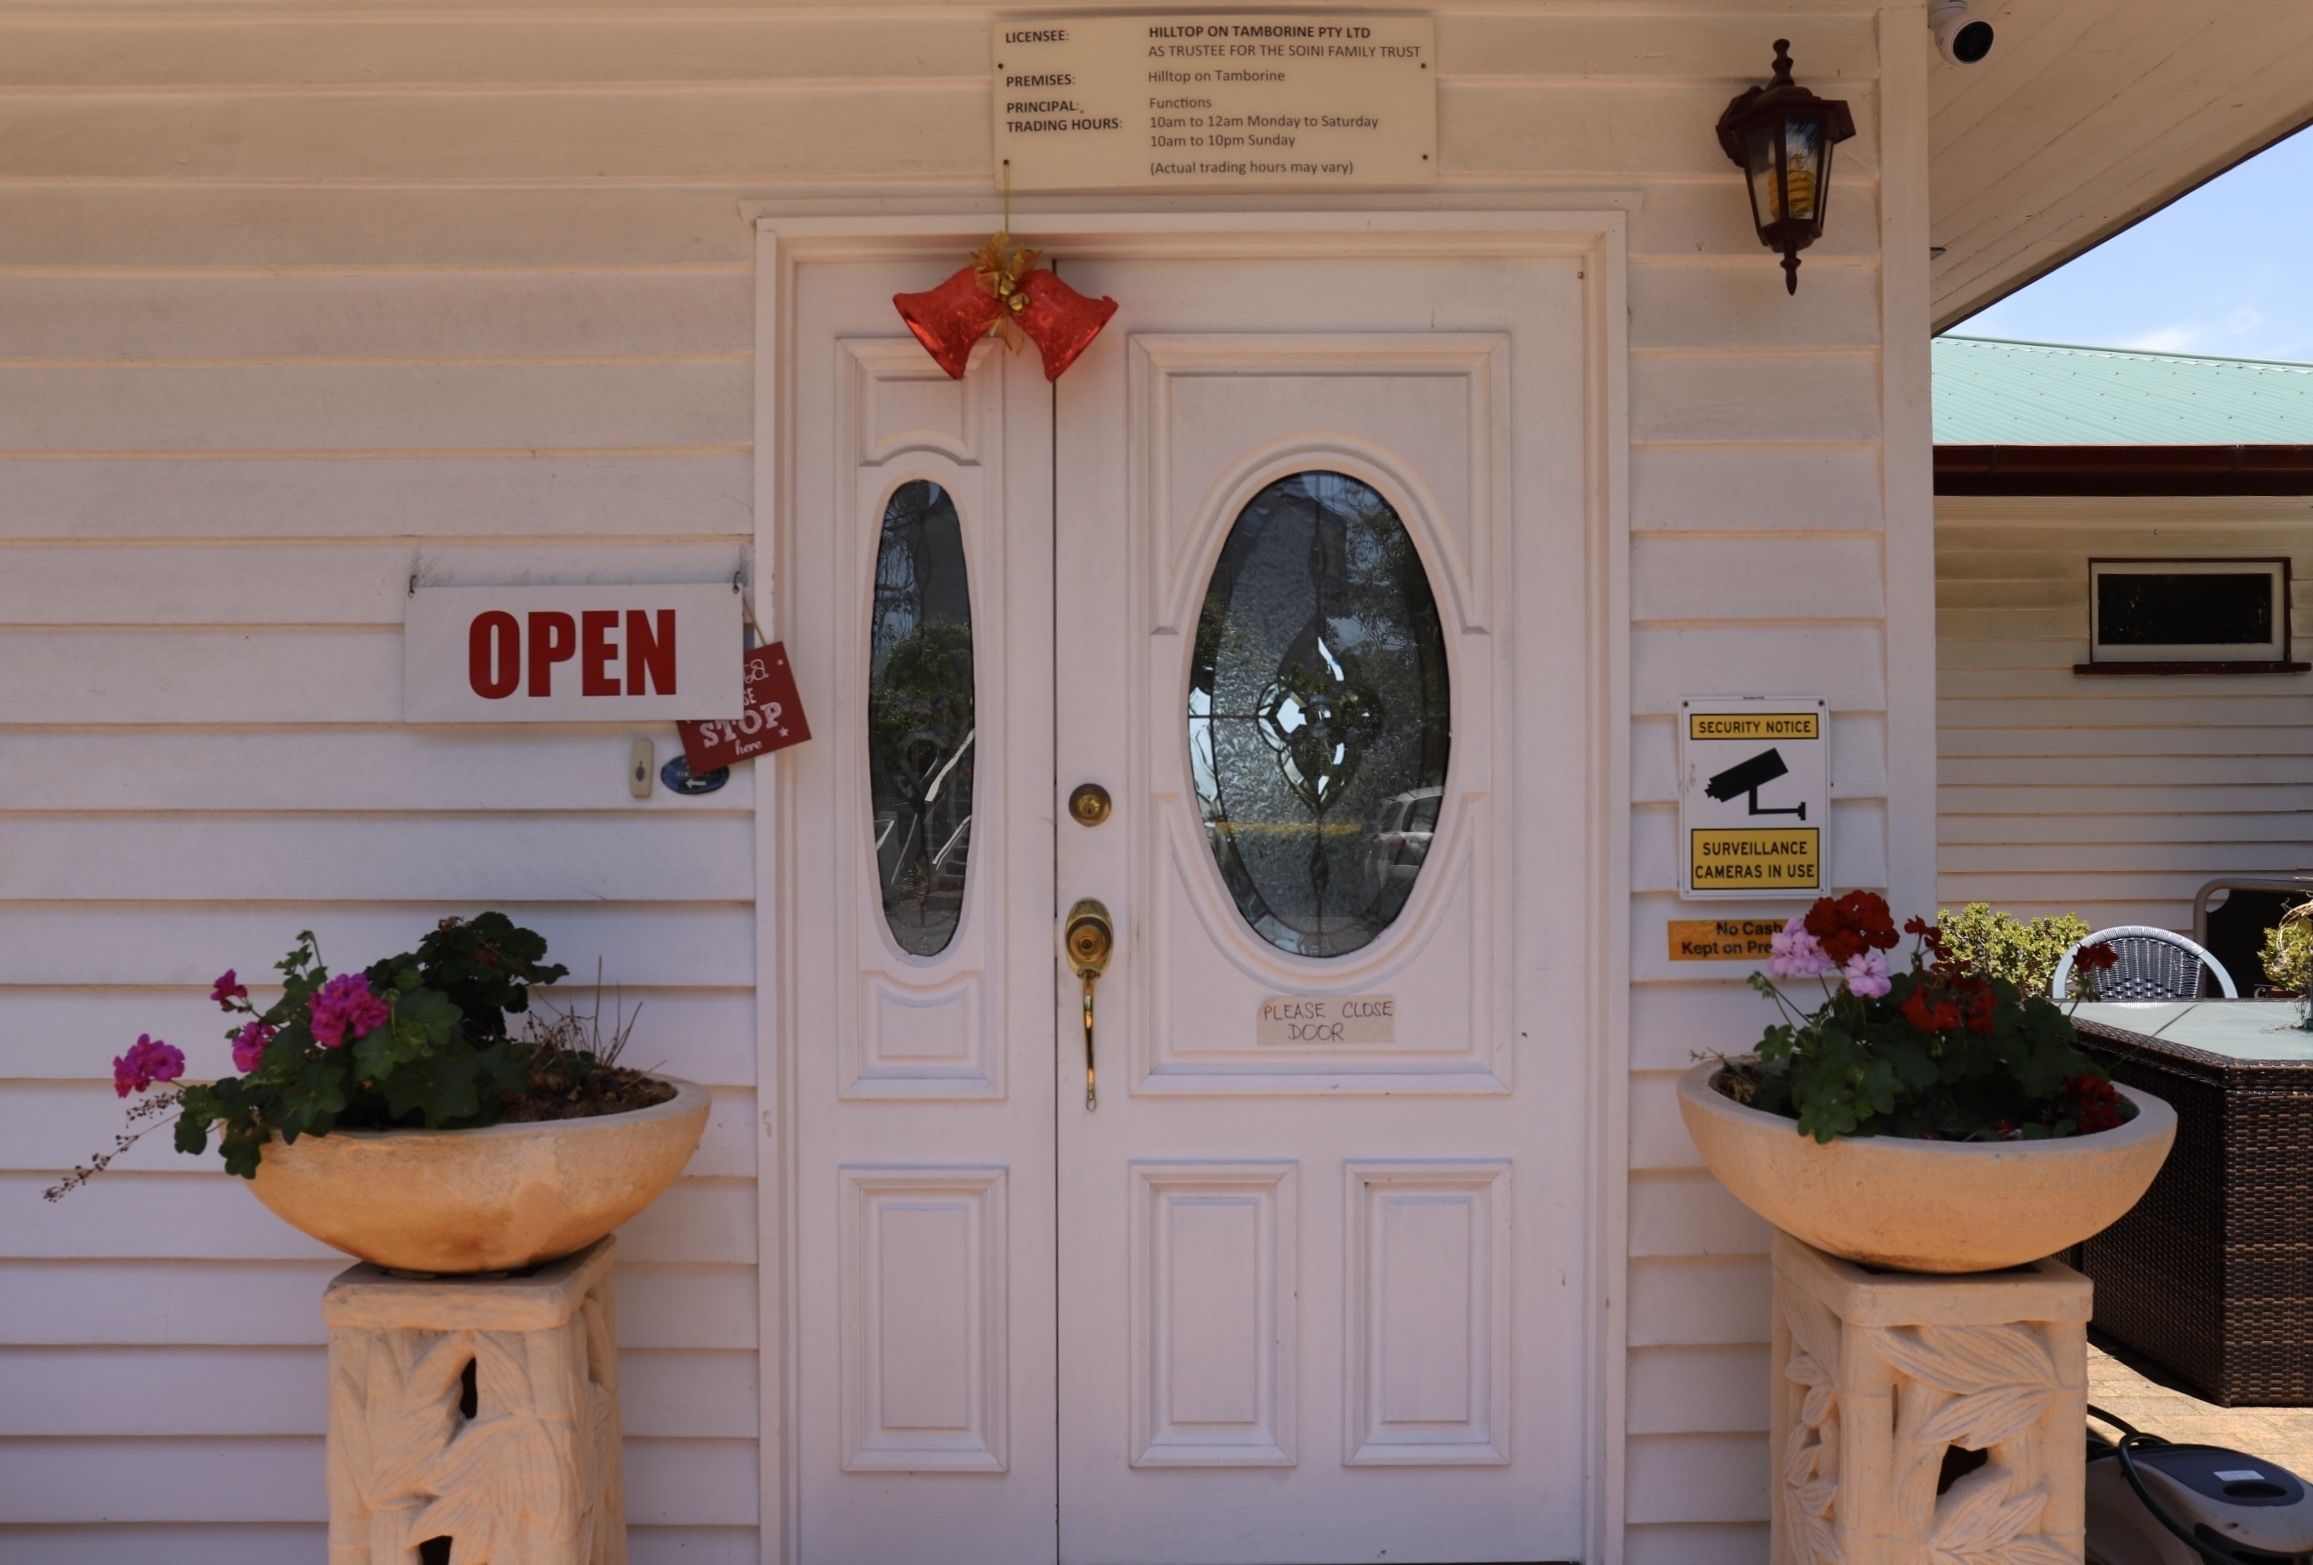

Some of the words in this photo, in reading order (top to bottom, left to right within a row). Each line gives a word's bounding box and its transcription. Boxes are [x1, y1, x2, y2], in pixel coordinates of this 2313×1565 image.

[1005, 30, 1070, 43] LICENSEE:
[1149, 26, 1204, 38] HILLTOP
[1207, 26, 1229, 37] ON
[1232, 26, 1315, 37] TAMBORINE
[1318, 27, 1343, 38] PTY
[1346, 27, 1371, 38] LTD
[1148, 45, 1165, 57] AS
[1168, 45, 1226, 56] TRUSTEE
[1229, 45, 1256, 56] FOR
[1259, 45, 1285, 56] THE
[1288, 45, 1324, 57] SOINI
[1328, 45, 1376, 57] FAMILY
[1380, 46, 1421, 58] TRUST
[1006, 74, 1076, 87] PREMISES:
[1148, 70, 1191, 84] Hilltop
[1194, 72, 1211, 81] on
[1214, 69, 1286, 81] Tamborine
[1006, 101, 1080, 114] PRINCIPAL:
[1149, 97, 1212, 109] Functions
[1007, 119, 1068, 132] TRADING
[1071, 117, 1123, 130] HOURS:
[1150, 116, 1186, 128] 10am
[1190, 116, 1203, 128] to
[1207, 116, 1243, 127] 12am
[1248, 115, 1300, 129] Monday
[1304, 116, 1317, 127] to
[1321, 115, 1379, 129] Saturday
[1150, 136, 1186, 147] 10am
[1190, 135, 1204, 147] to
[1208, 135, 1244, 149] 10pm
[1248, 134, 1296, 148] Sunday
[1150, 161, 1196, 176] (Actual
[1199, 161, 1247, 175] trading
[1250, 161, 1287, 173] hours
[1290, 163, 1318, 175] may
[1321, 161, 1354, 175] vary)
[469, 608, 677, 700] OPEN
[700, 701, 783, 748] STOP
[1698, 721, 1761, 734] SECURITY
[1766, 720, 1812, 733] NOTICE
[735, 740, 763, 756] here
[1702, 841, 1808, 856] SURVEILLANCE
[1695, 864, 1763, 879] CAMERAS
[1768, 864, 1782, 878] IN
[1787, 864, 1815, 878] USE
[1716, 922, 1739, 936] No
[1742, 922, 1783, 936] Cash
[1682, 941, 1719, 958] Kept
[1723, 943, 1743, 954] on
[1264, 1002, 1327, 1021] PLEASE
[1341, 1000, 1393, 1018] CLOSE
[1287, 1022, 1345, 1042] DOOR
